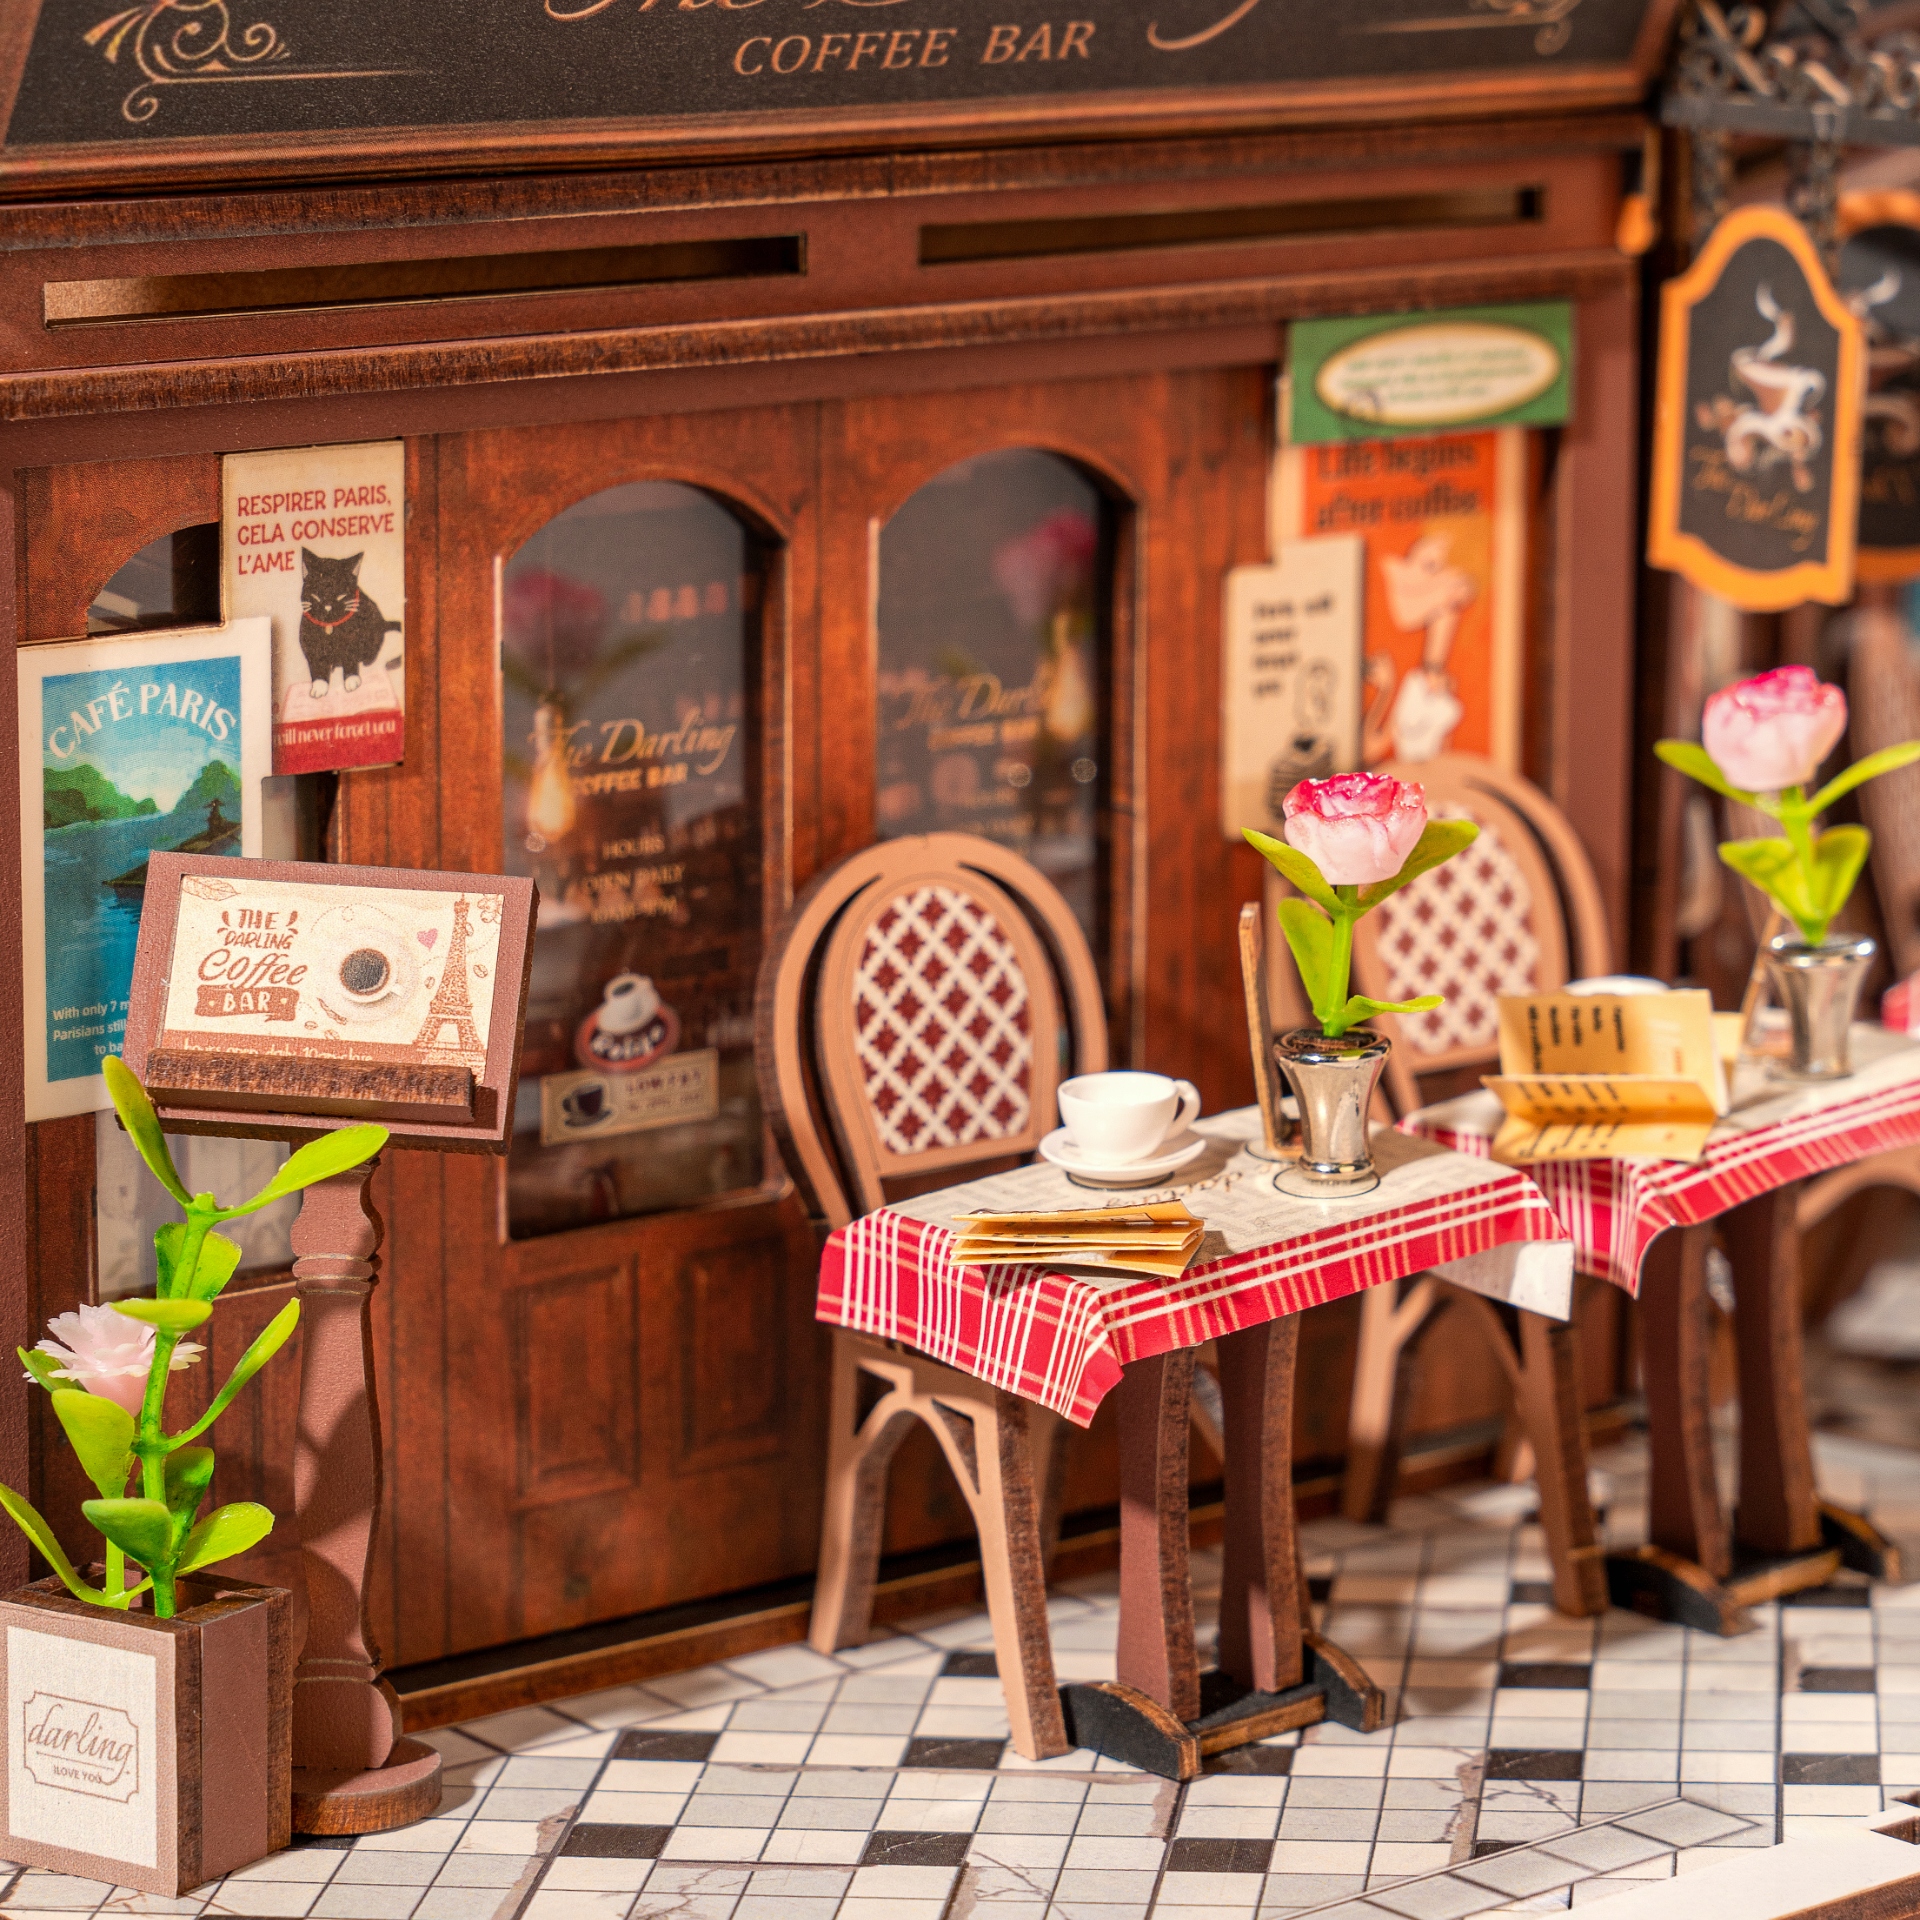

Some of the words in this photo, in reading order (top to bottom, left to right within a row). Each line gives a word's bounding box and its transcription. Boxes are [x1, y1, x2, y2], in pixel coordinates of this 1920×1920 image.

[732, 26, 958, 77] COFFEE
[979, 21, 1097, 66] BAR
[237, 490, 327, 517] RESPIRER
[334, 485, 392, 509] PARIS,
[237, 523, 286, 546] CELA
[291, 512, 395, 541] CONSERVE
[238, 550, 295, 576] L'AME
[49, 680, 133, 759] CAFÉ
[140, 683, 237, 741] PARIS
[298, 727, 334, 743] never
[600, 706, 736, 776] Darling
[238, 909, 280, 929] THE
[224, 930, 294, 950] DARLING
[198, 948, 308, 990] Coffee
[52, 1006, 79, 1021] With
[82, 1003, 108, 1017] only
[110, 999, 117, 1012] 7
[222, 991, 271, 1012] BAR
[53, 1025, 105, 1042] Parisians
[93, 1044, 106, 1055] to
[28, 1704, 134, 1785] darling
[82, 1771, 102, 1785] YOU
